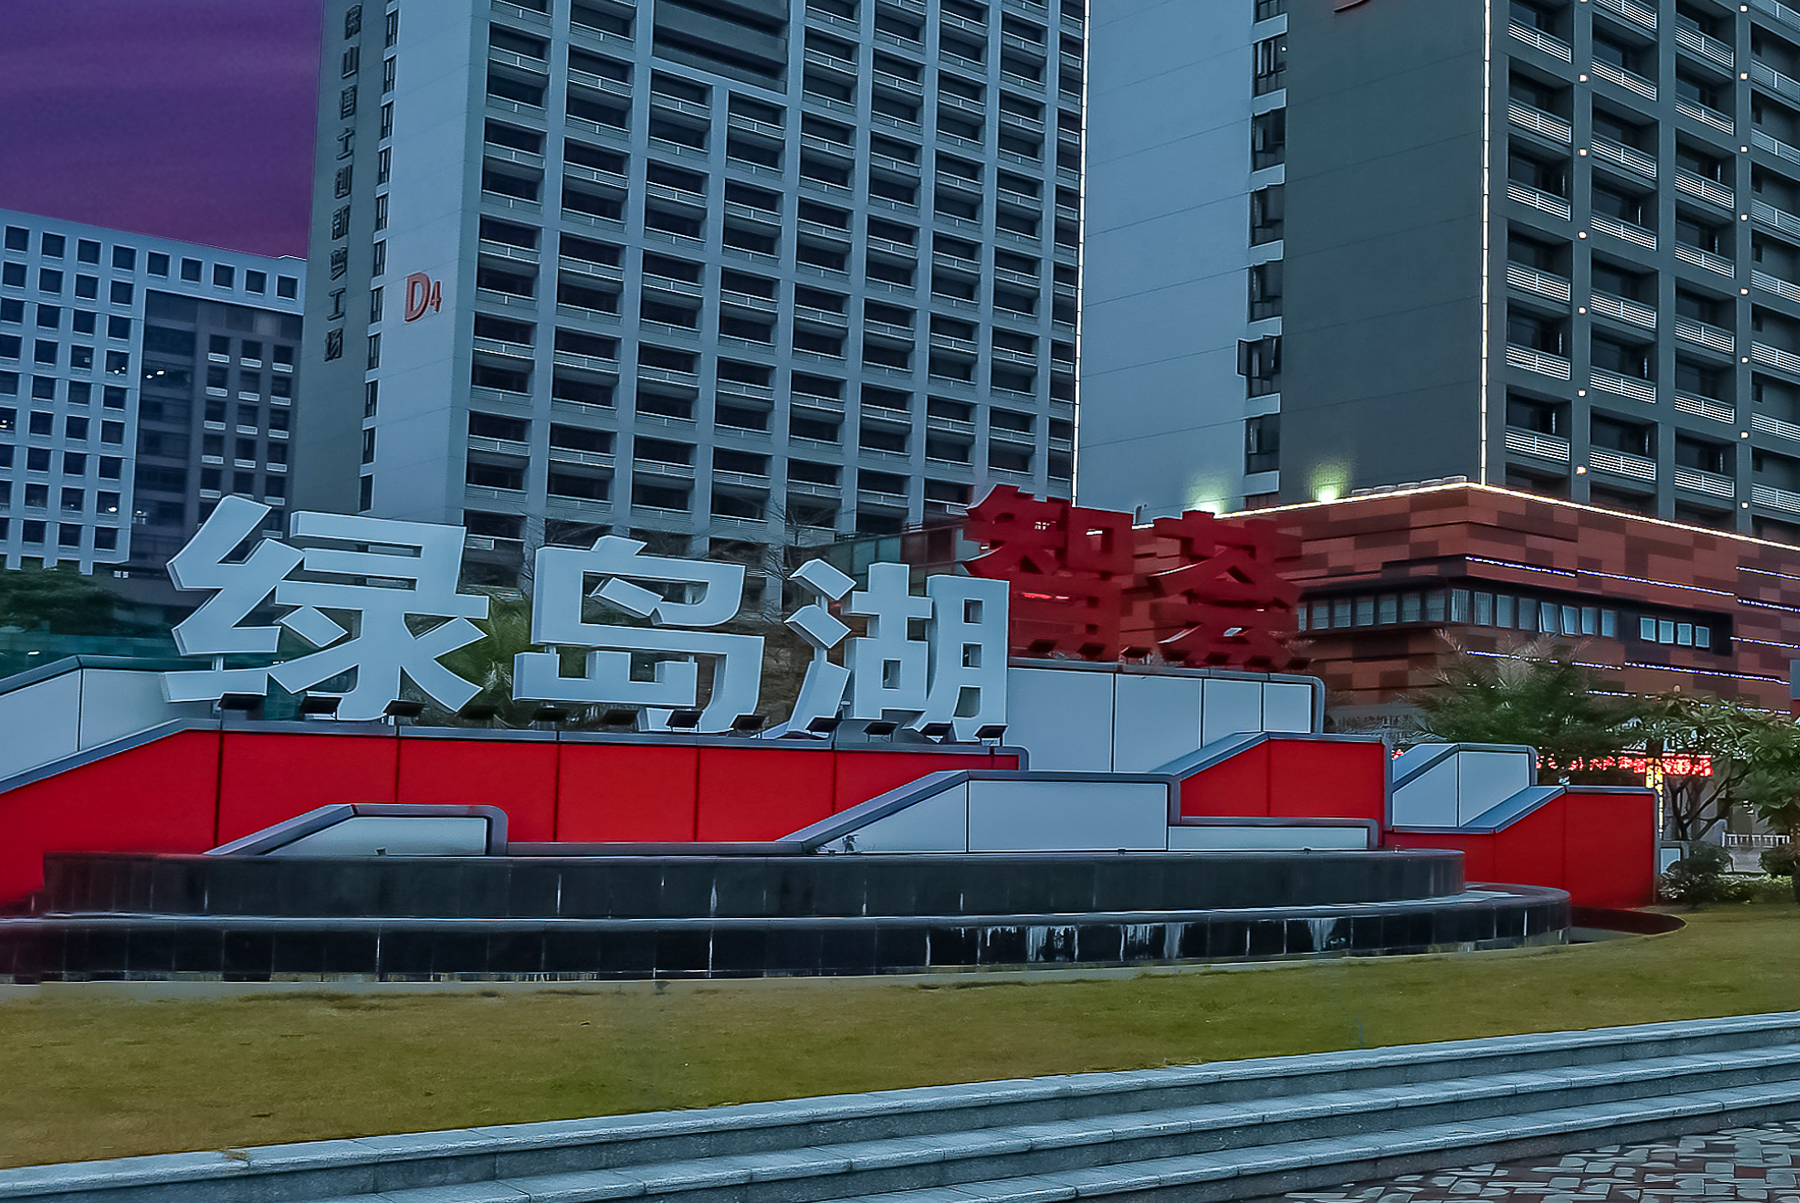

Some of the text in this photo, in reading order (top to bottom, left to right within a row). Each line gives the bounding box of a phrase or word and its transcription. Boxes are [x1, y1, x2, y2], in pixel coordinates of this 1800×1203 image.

[404, 272, 442, 322] D4
[159, 494, 1010, 744] 绿岛湖
